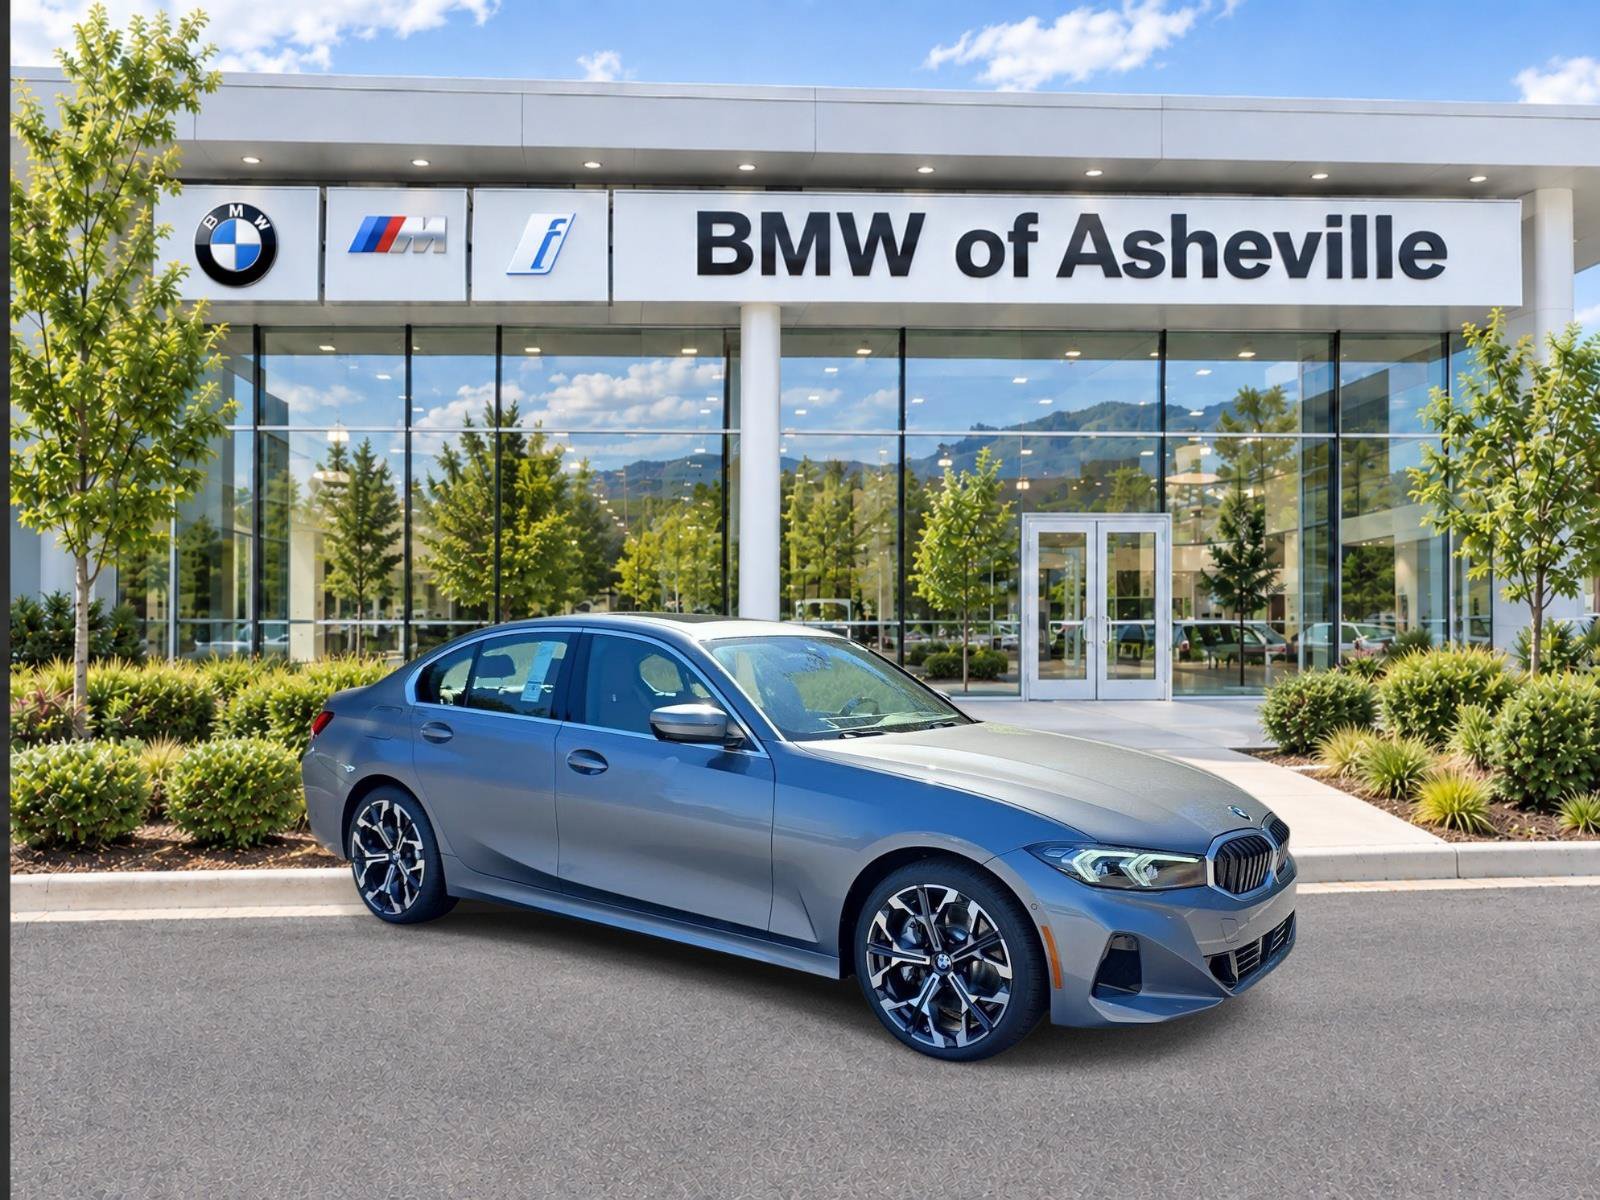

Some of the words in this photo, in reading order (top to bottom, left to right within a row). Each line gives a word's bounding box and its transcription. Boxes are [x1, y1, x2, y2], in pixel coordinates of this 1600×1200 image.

[202, 204, 270, 230] BMW
[697, 211, 926, 276] BMW
[955, 212, 1038, 278] of
[1056, 213, 1448, 280] Asheville
